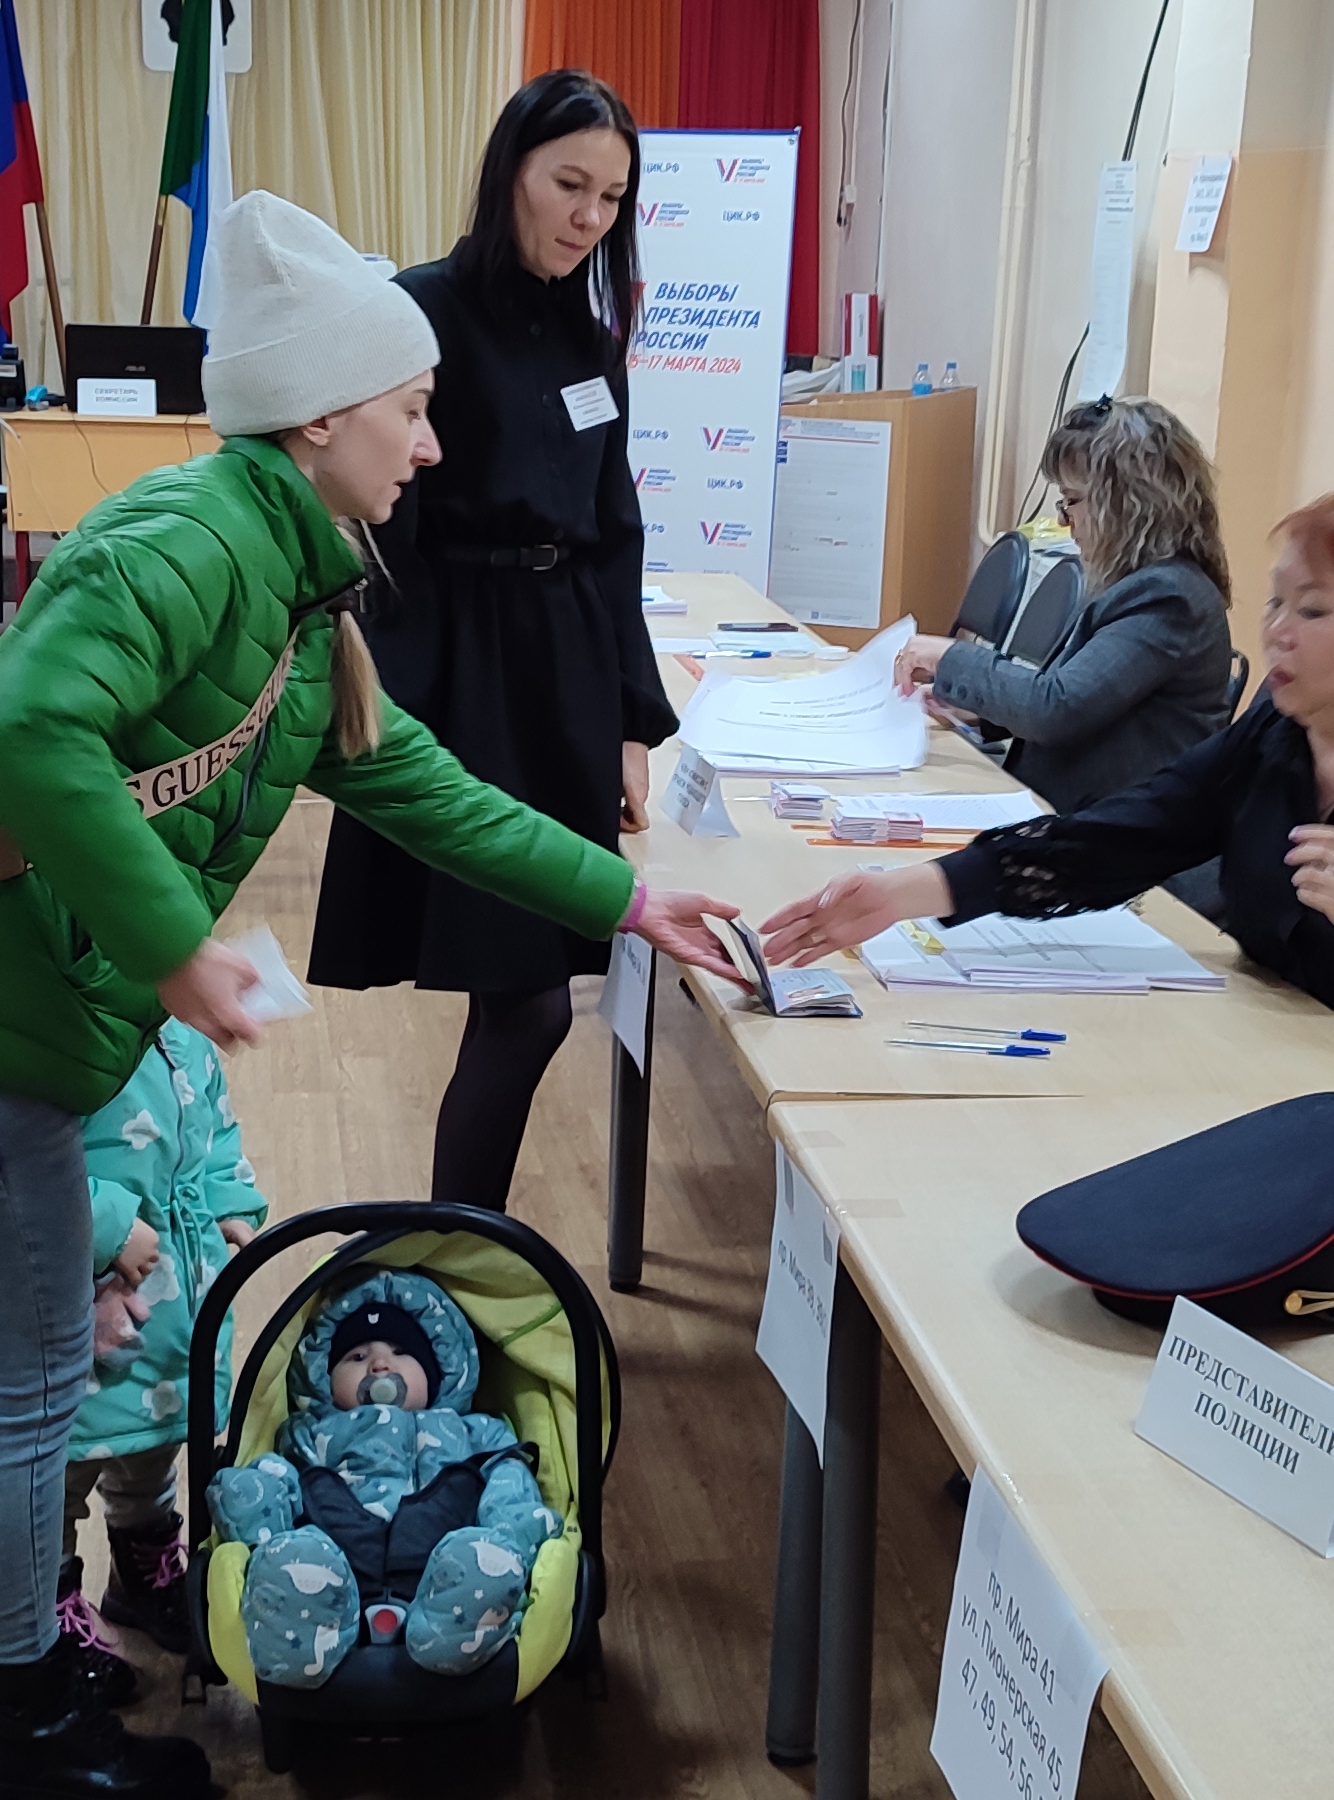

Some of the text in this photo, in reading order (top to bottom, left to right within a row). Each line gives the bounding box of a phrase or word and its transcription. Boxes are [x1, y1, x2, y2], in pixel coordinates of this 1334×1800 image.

[722, 210, 760, 222] ЦИК.РФ
[654, 282, 740, 303] ВЫБОРЫ
[645, 306, 762, 330] ПРЕЗИДЕНТА
[635, 331, 710, 352] РОССИИ
[662, 355, 708, 373] МАРТА
[708, 357, 742, 374] 2024
[632, 429, 669, 441] ЦИК.РФ
[707, 477, 744, 490] ЦИК.РФ
[151, 711, 257, 809] GUESS
[1193, 1390, 1301, 1476] ПОЛИЦИИ
[987, 1570, 1056, 1705] пр. Мира 41
[961, 1594, 979, 1639] ул.
[981, 1619, 1047, 1763] Пионерская
